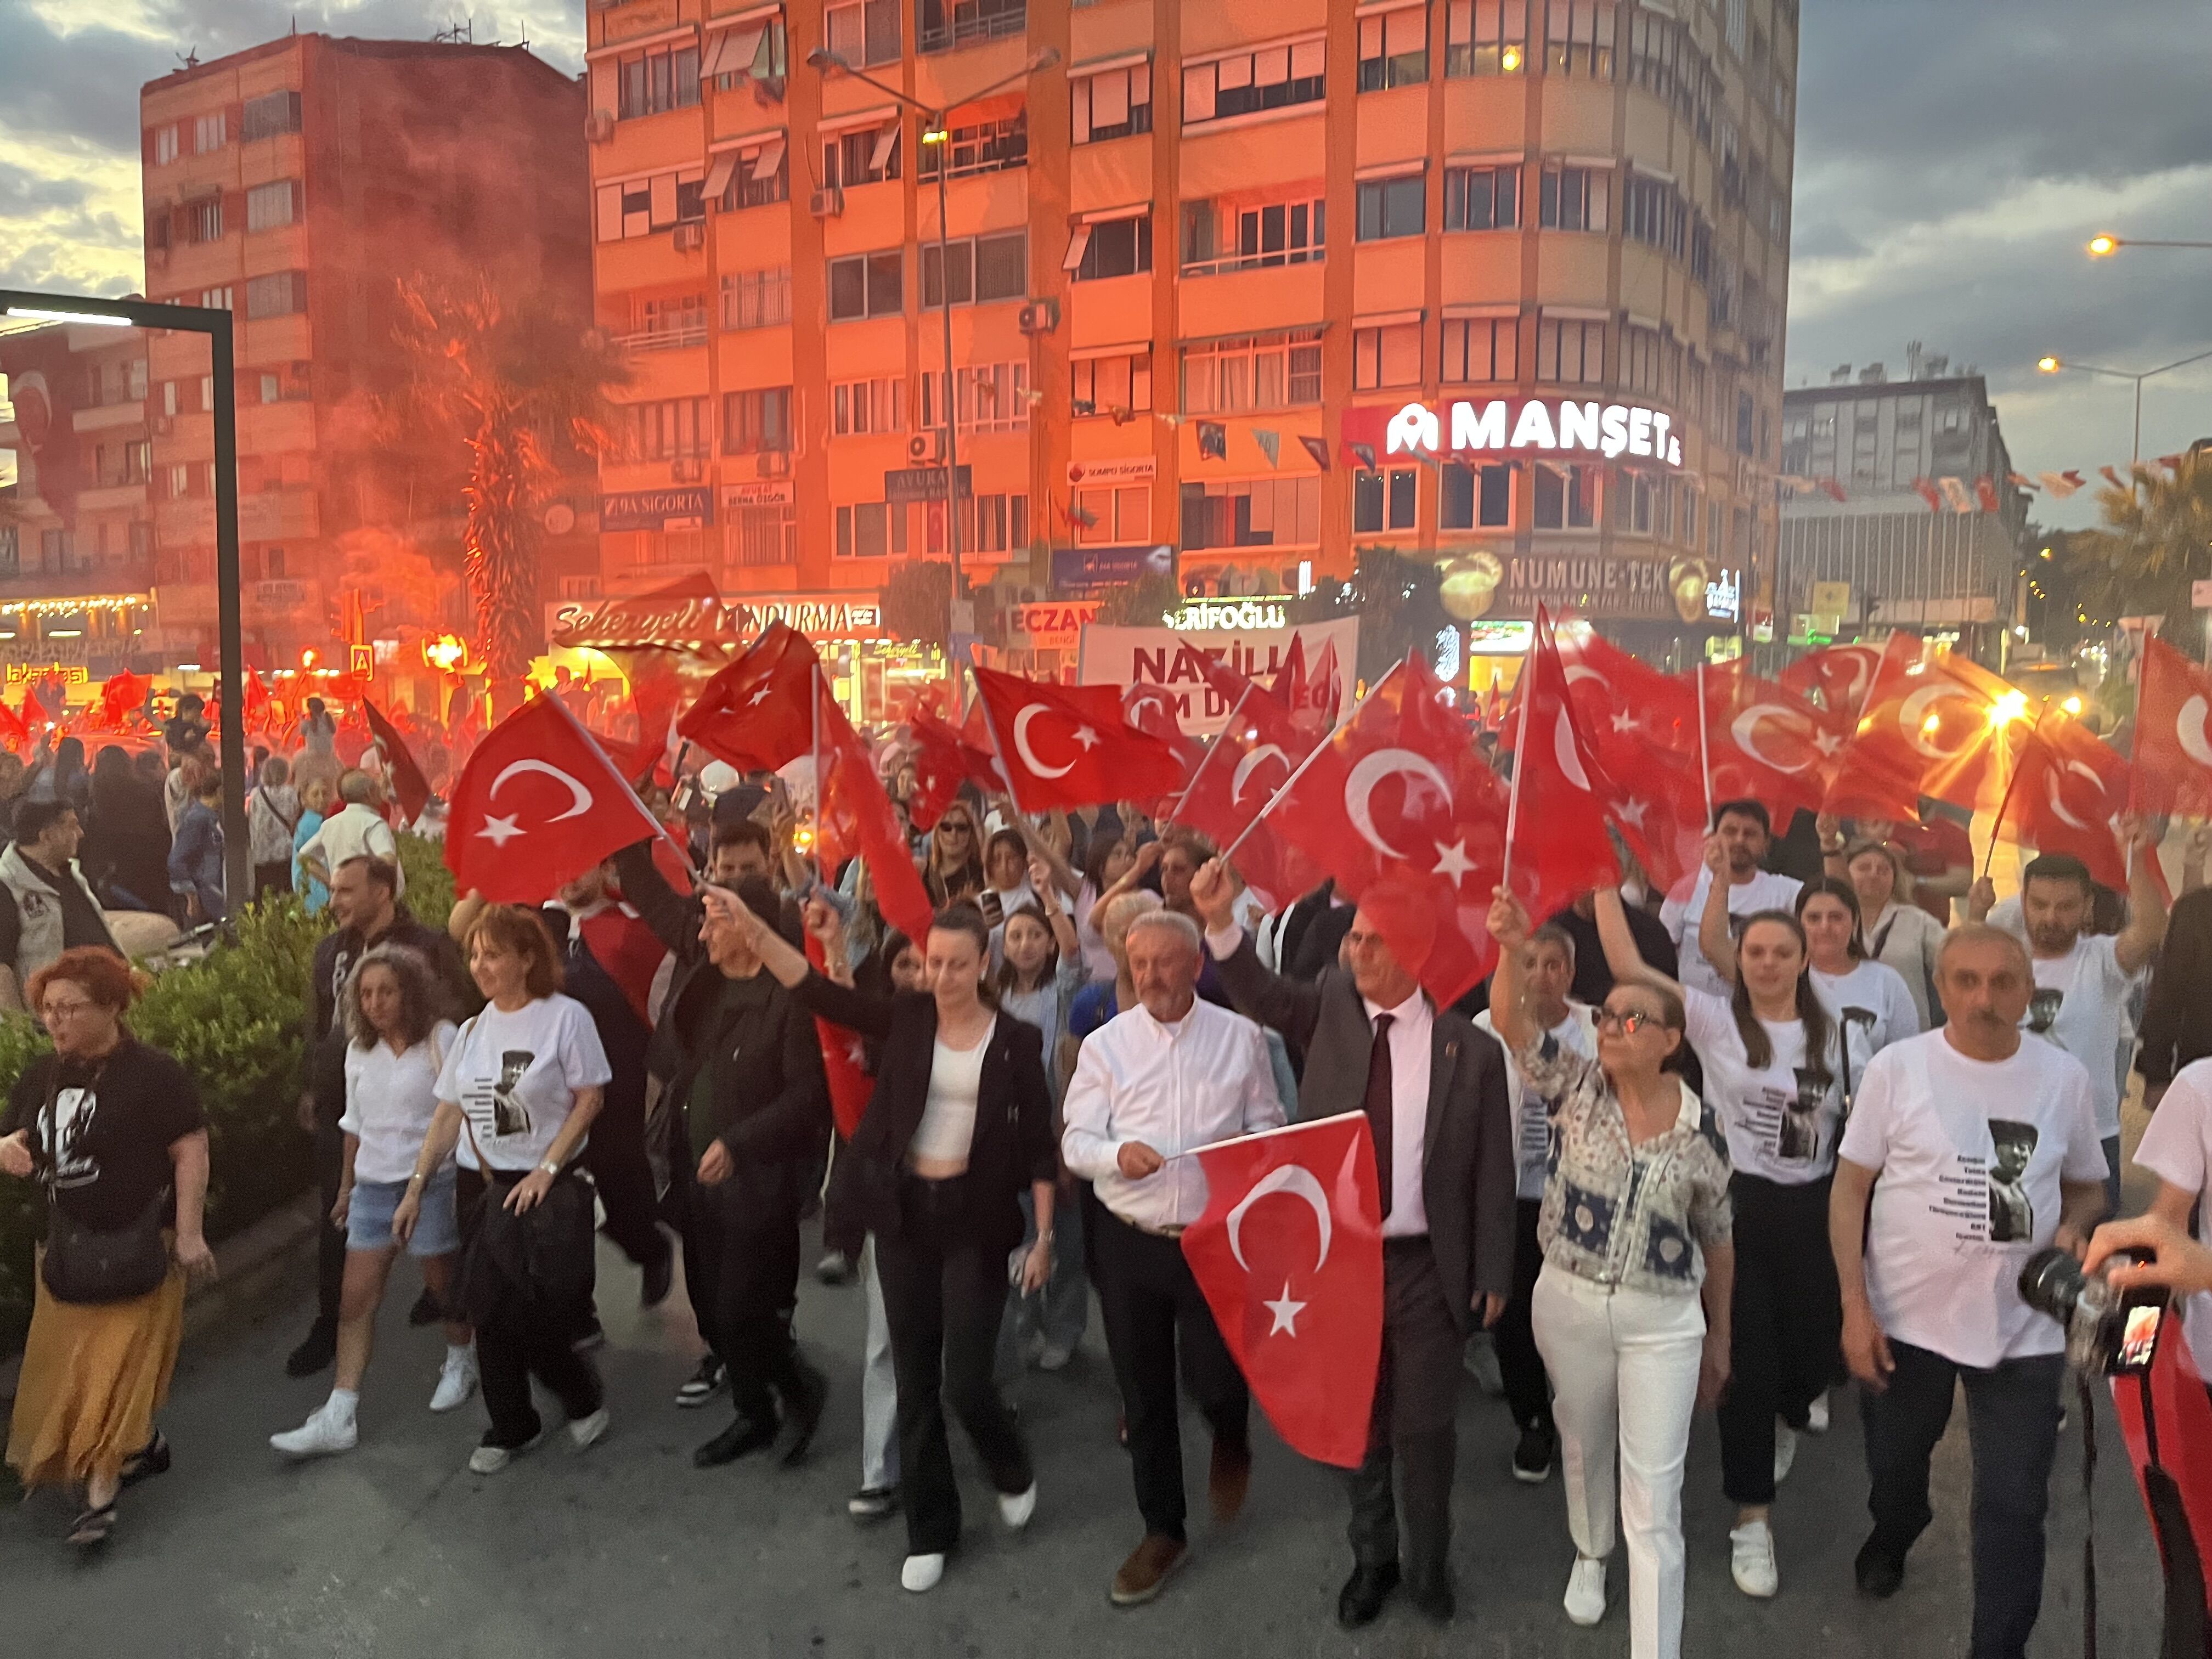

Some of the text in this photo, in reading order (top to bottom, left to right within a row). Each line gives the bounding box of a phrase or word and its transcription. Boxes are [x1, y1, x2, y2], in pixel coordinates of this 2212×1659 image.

[1452, 399, 1670, 460] MANŞET
[897, 470, 958, 489] AVUKA
[1011, 608, 1096, 631] ECZAN
